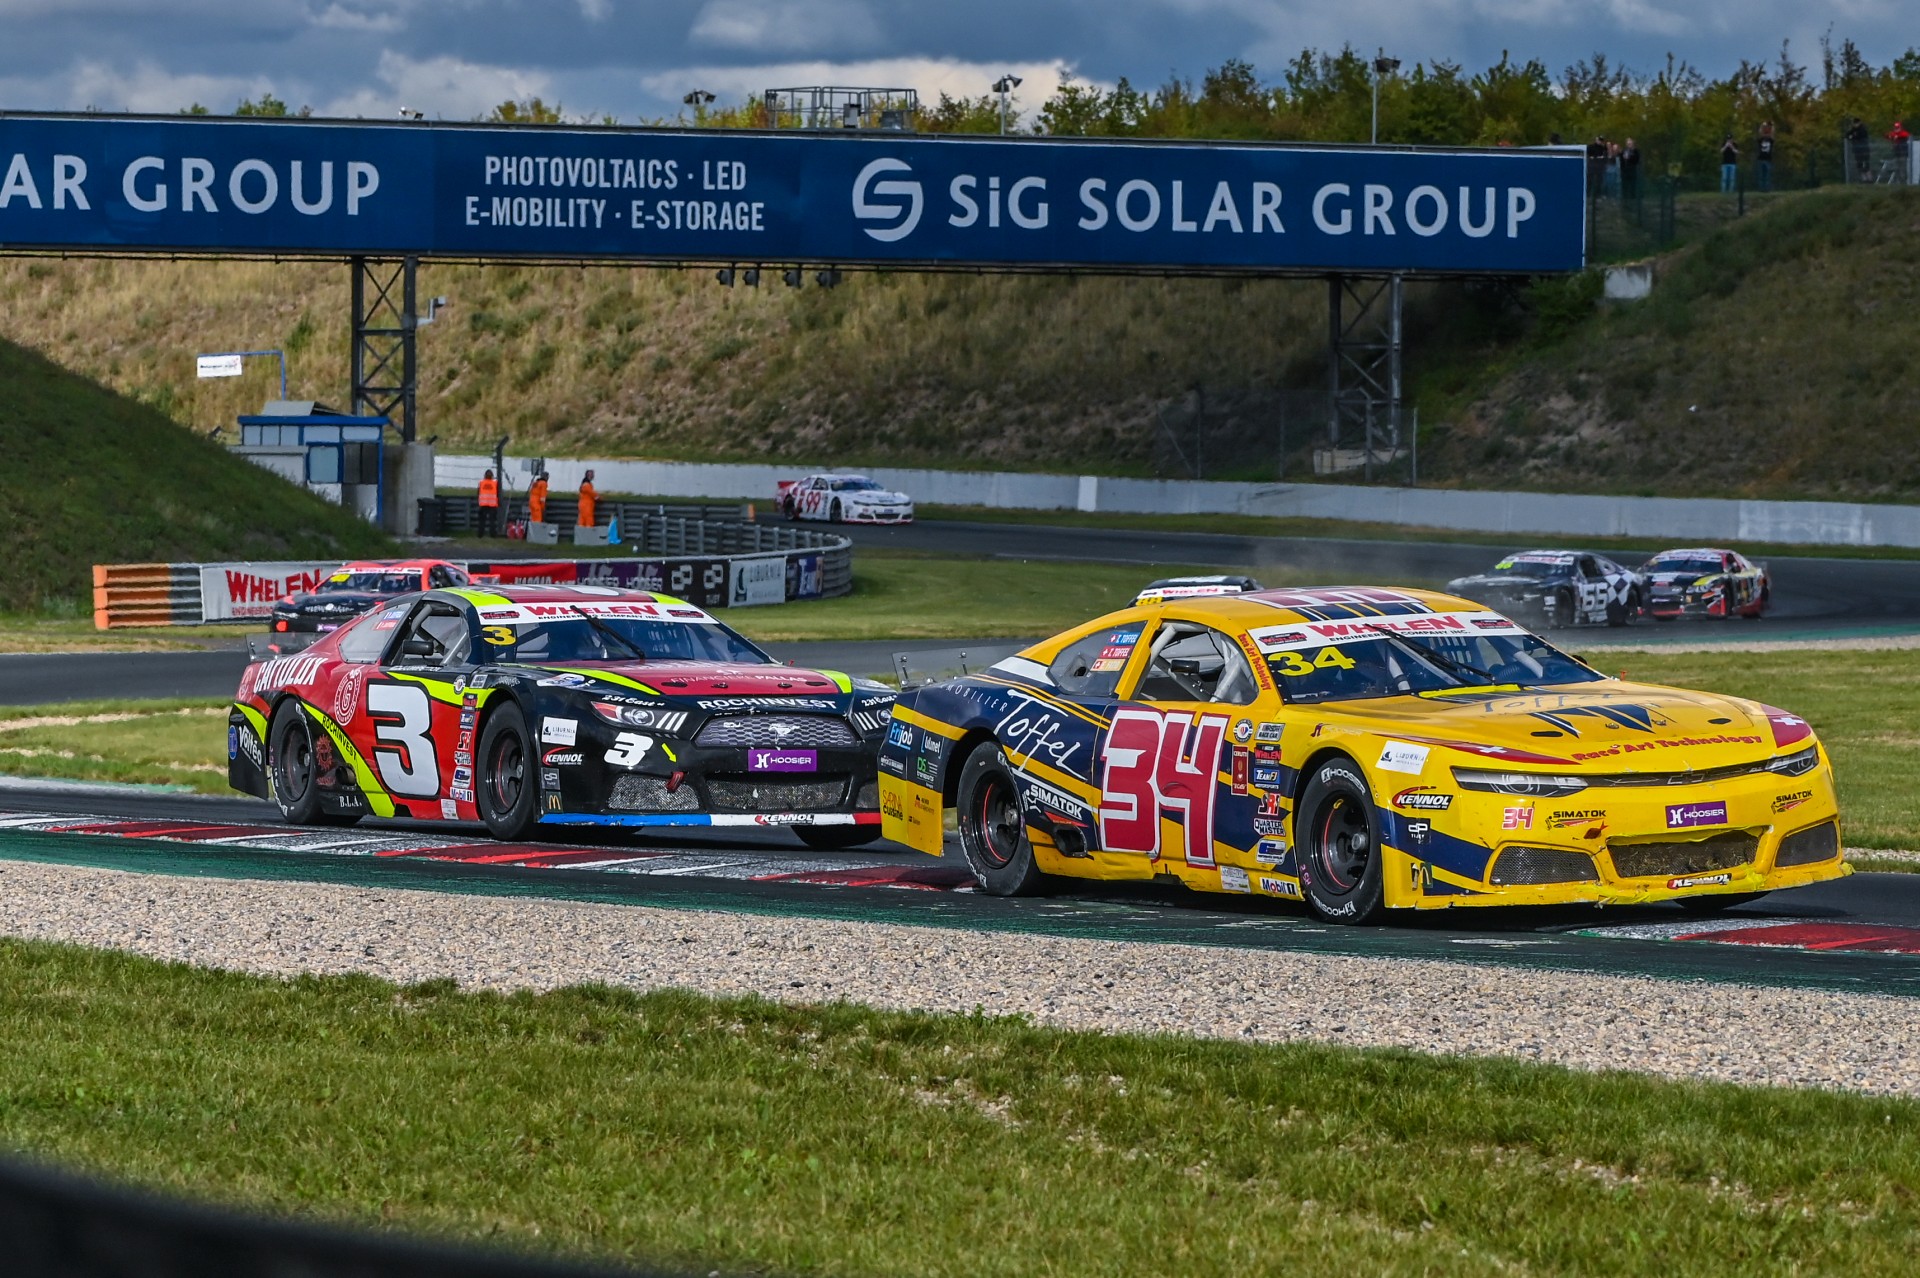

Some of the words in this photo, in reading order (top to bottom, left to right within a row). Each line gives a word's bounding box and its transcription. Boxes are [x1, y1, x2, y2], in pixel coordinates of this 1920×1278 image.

[485, 156, 679, 189] PHOTOVOLTAICS
[703, 160, 747, 192] LED
[122, 155, 380, 217] GROUP
[465, 195, 603, 229] E-MOBILITY
[630, 200, 765, 232] E-STORAGE
[948, 174, 1050, 230] SiG
[1078, 177, 1285, 234] SOLAR
[1311, 183, 1536, 239] GROUP
[225, 569, 320, 603] WHELEN
[523, 605, 660, 616] WHELEN
[482, 626, 517, 646] 3
[1306, 616, 1465, 638] WHELEN
[1268, 646, 1357, 677] 34
[697, 697, 836, 709] ROCHINVEST
[367, 682, 440, 797] 3
[603, 731, 654, 768] 3
[1655, 734, 1763, 749] Technology
[545, 753, 584, 763] KENNOL
[1099, 706, 1232, 869] 34
[1776, 790, 1813, 802] SIMATOK
[1031, 784, 1082, 819] SIMATOK
[1396, 794, 1451, 806] KENNOL
[760, 813, 814, 822] KENNOL
[1502, 807, 1534, 830] 34
[1553, 809, 1607, 819] SIMATOK
[1683, 808, 1725, 819] HOOSIER
[1261, 878, 1287, 894] Mobil
